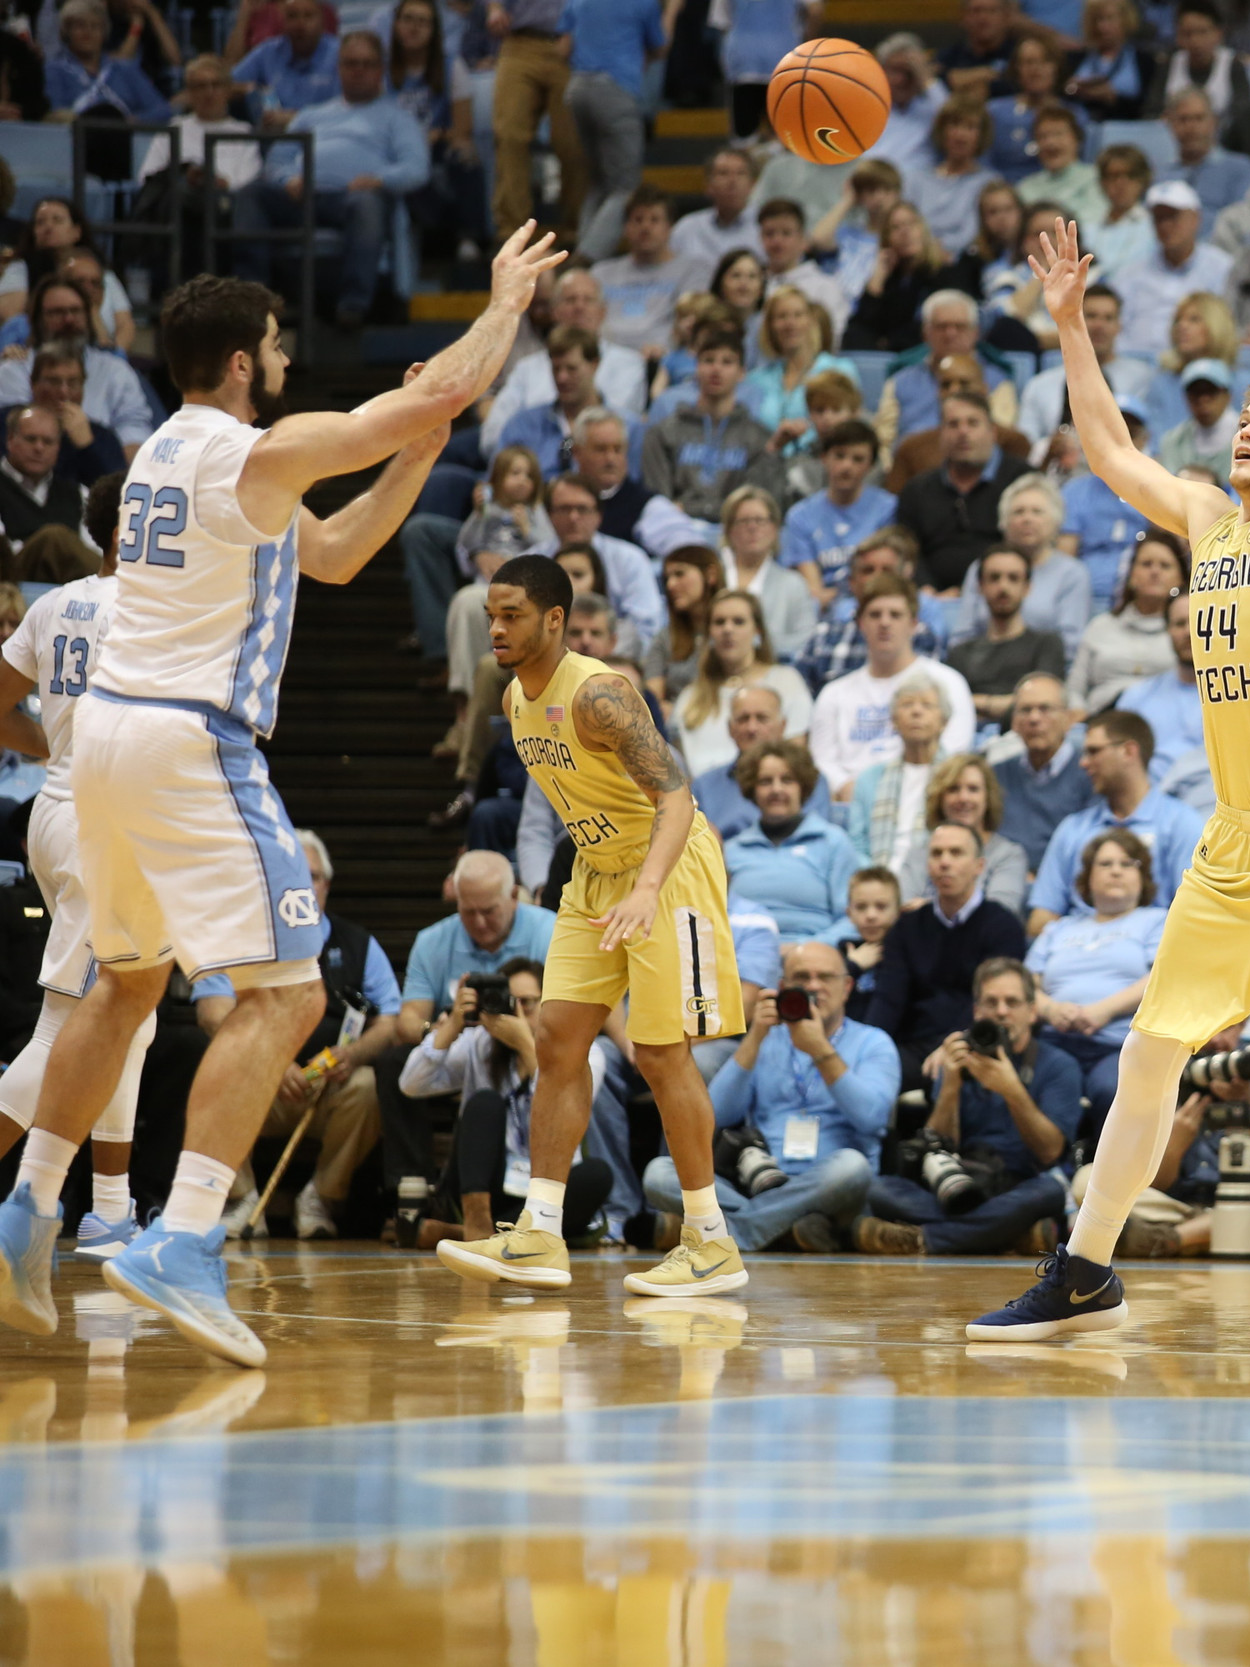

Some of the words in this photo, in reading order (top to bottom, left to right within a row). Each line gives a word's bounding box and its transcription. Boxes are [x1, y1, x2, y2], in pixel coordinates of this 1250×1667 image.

[120, 482, 188, 568] 32
[1197, 603, 1237, 652] 44
[50, 634, 89, 696] 13
[516, 736, 578, 772] GEORGIA
[551, 776, 572, 812] 1
[565, 811, 620, 848] ECH
